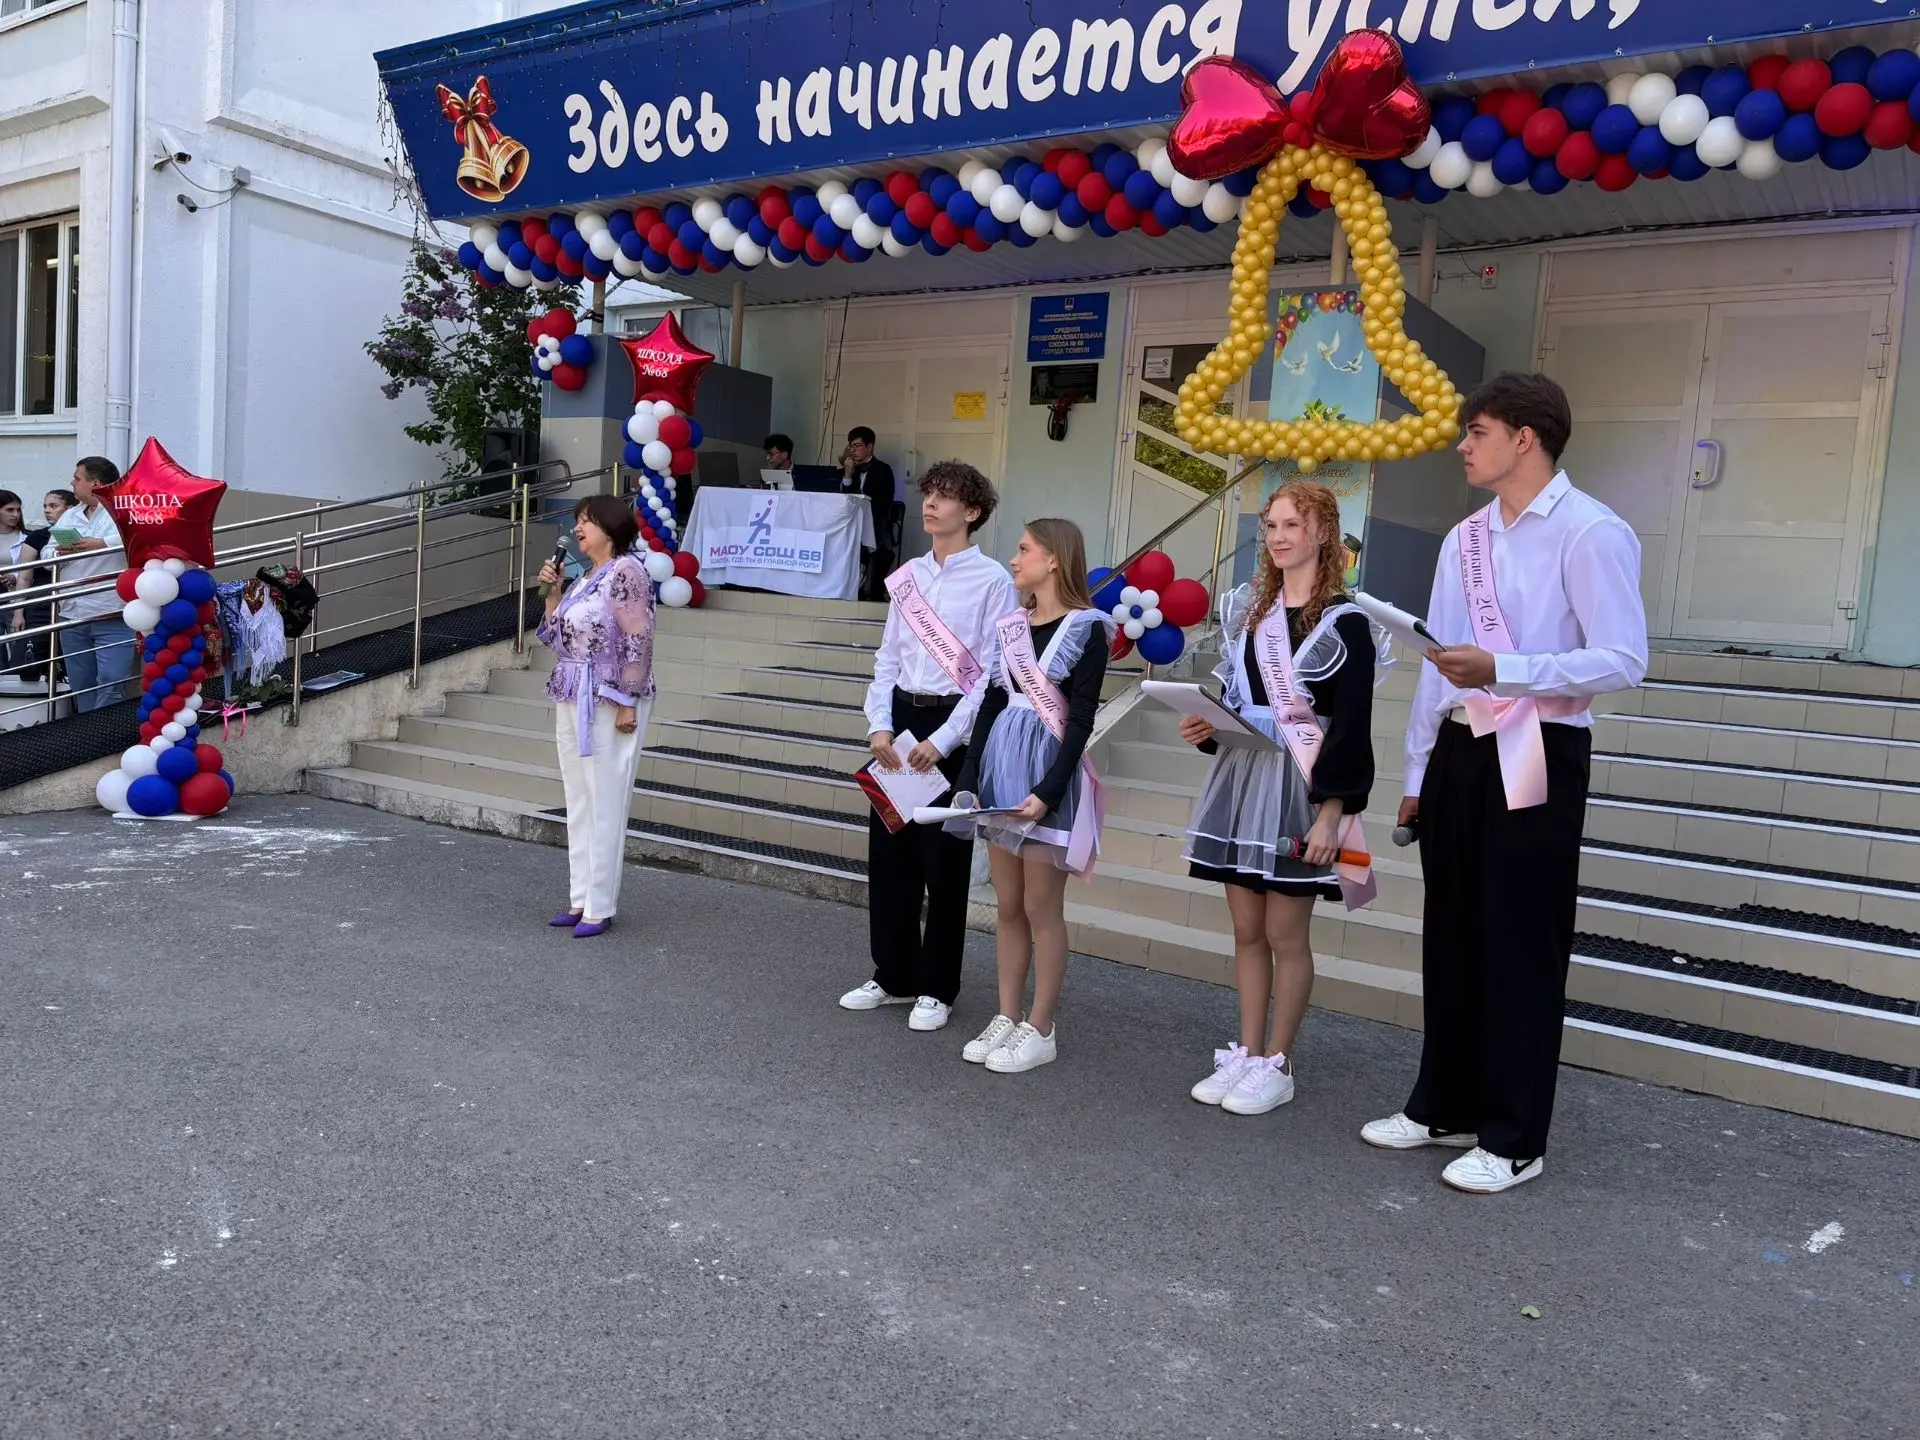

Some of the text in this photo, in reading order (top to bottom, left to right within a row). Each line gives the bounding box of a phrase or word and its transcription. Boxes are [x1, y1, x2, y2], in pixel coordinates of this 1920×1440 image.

[564, 79, 729, 174] Здесь
[637, 348, 686, 365] ШКОЛА
[642, 364, 669, 378] №68
[113, 493, 184, 510] ШКОЛА
[128, 510, 165, 525] №68
[710, 545, 822, 562] МАОУ СОШ 68
